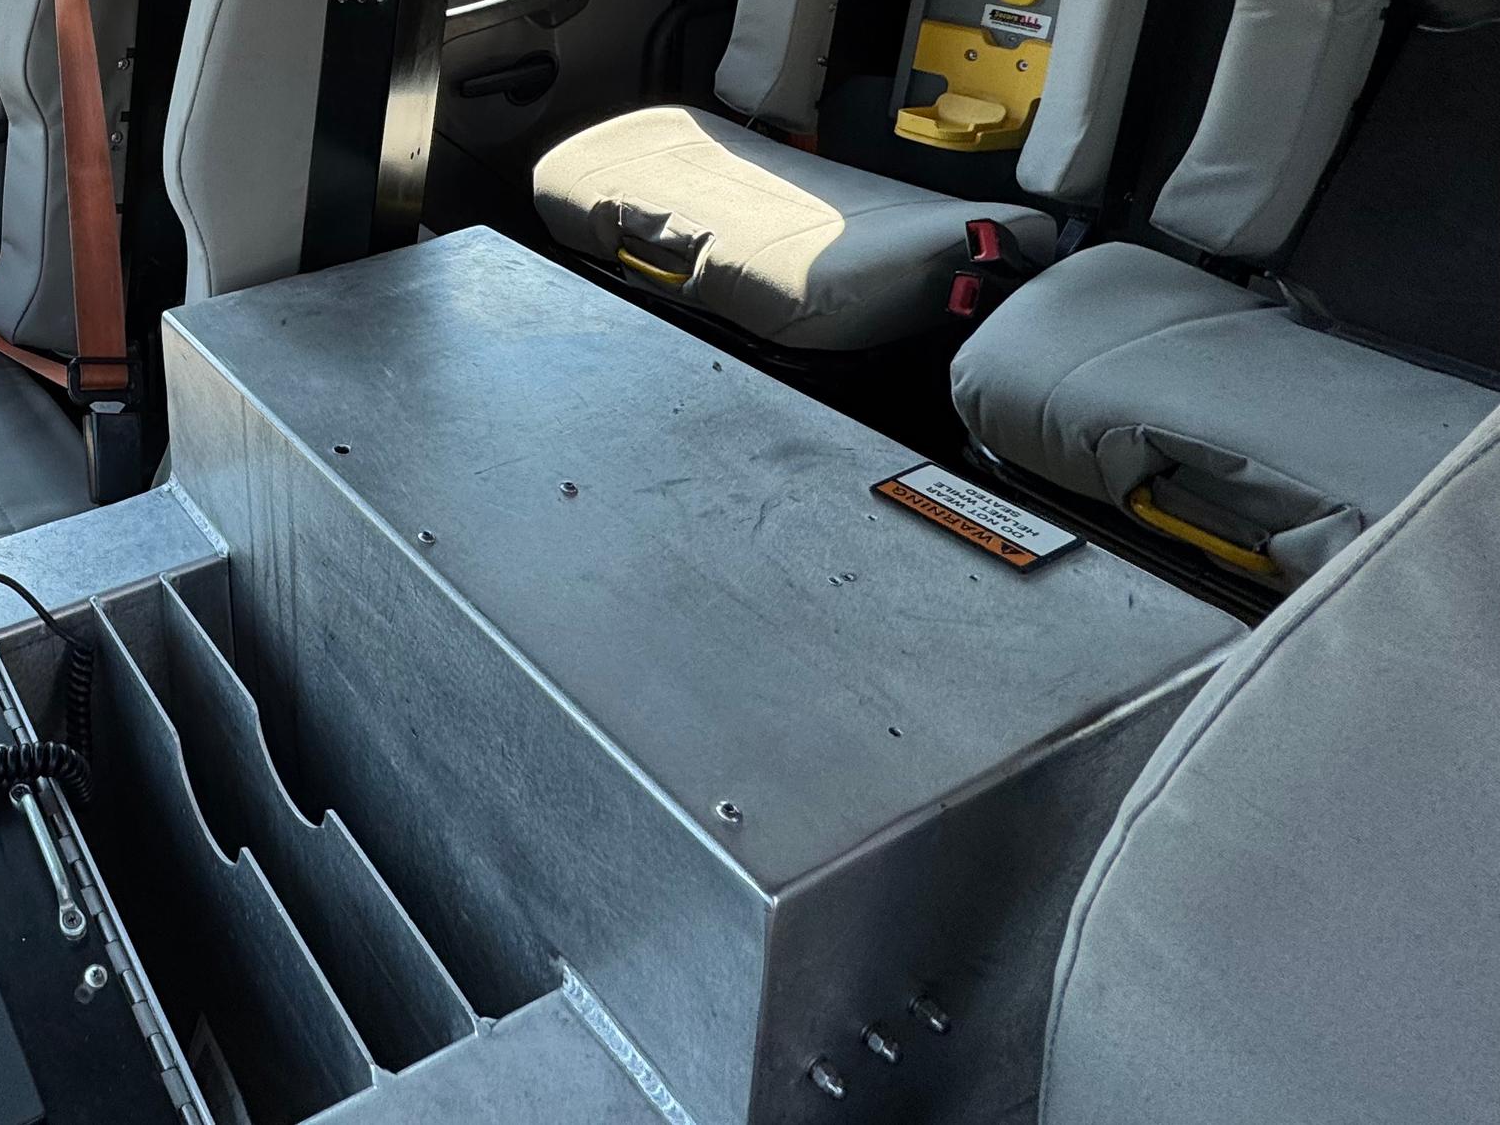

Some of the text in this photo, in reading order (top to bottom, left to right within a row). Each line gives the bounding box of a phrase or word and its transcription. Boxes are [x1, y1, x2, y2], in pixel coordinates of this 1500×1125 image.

[891, 485, 994, 544] WARNING
[926, 486, 1025, 538] DO NOT WEAR
[933, 482, 1040, 536] HELMET WHILE
[966, 488, 1021, 518] SEATED
